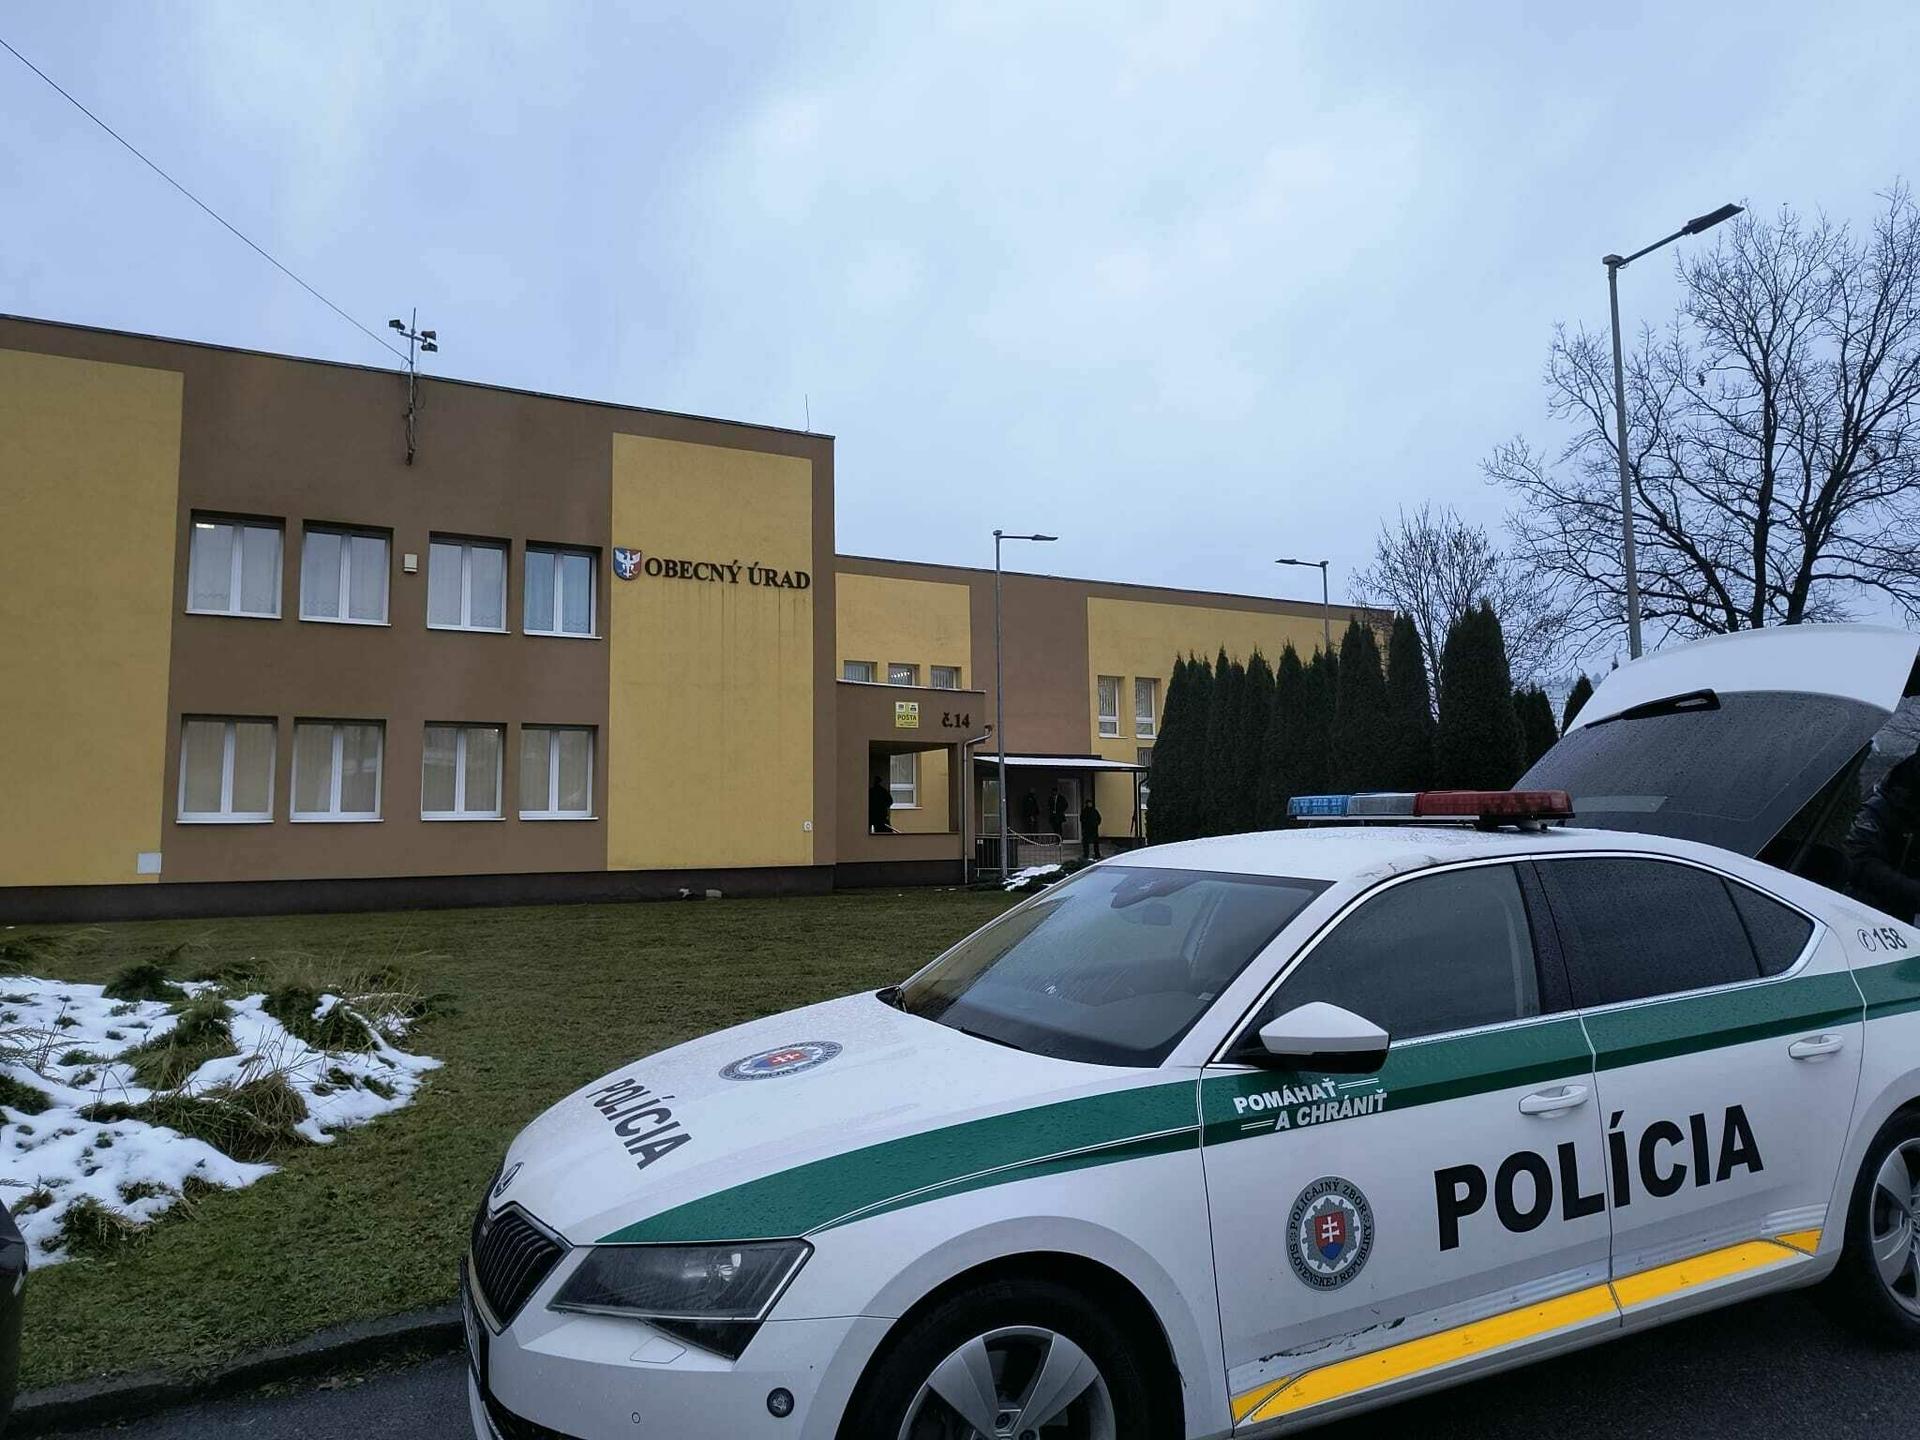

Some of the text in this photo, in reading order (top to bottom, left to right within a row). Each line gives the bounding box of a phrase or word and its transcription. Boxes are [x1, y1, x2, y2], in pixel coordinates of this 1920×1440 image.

[644, 557, 811, 589] OBECNÝ ÚRAD
[897, 712, 917, 721] POŠTA
[1233, 1078, 1336, 1114] POMÁHAŤ
[1275, 1088, 1388, 1131] A CHRÁNIŤ
[585, 1078, 692, 1170] POLÍCIA
[1433, 1104, 1764, 1252] POLÍCIA
